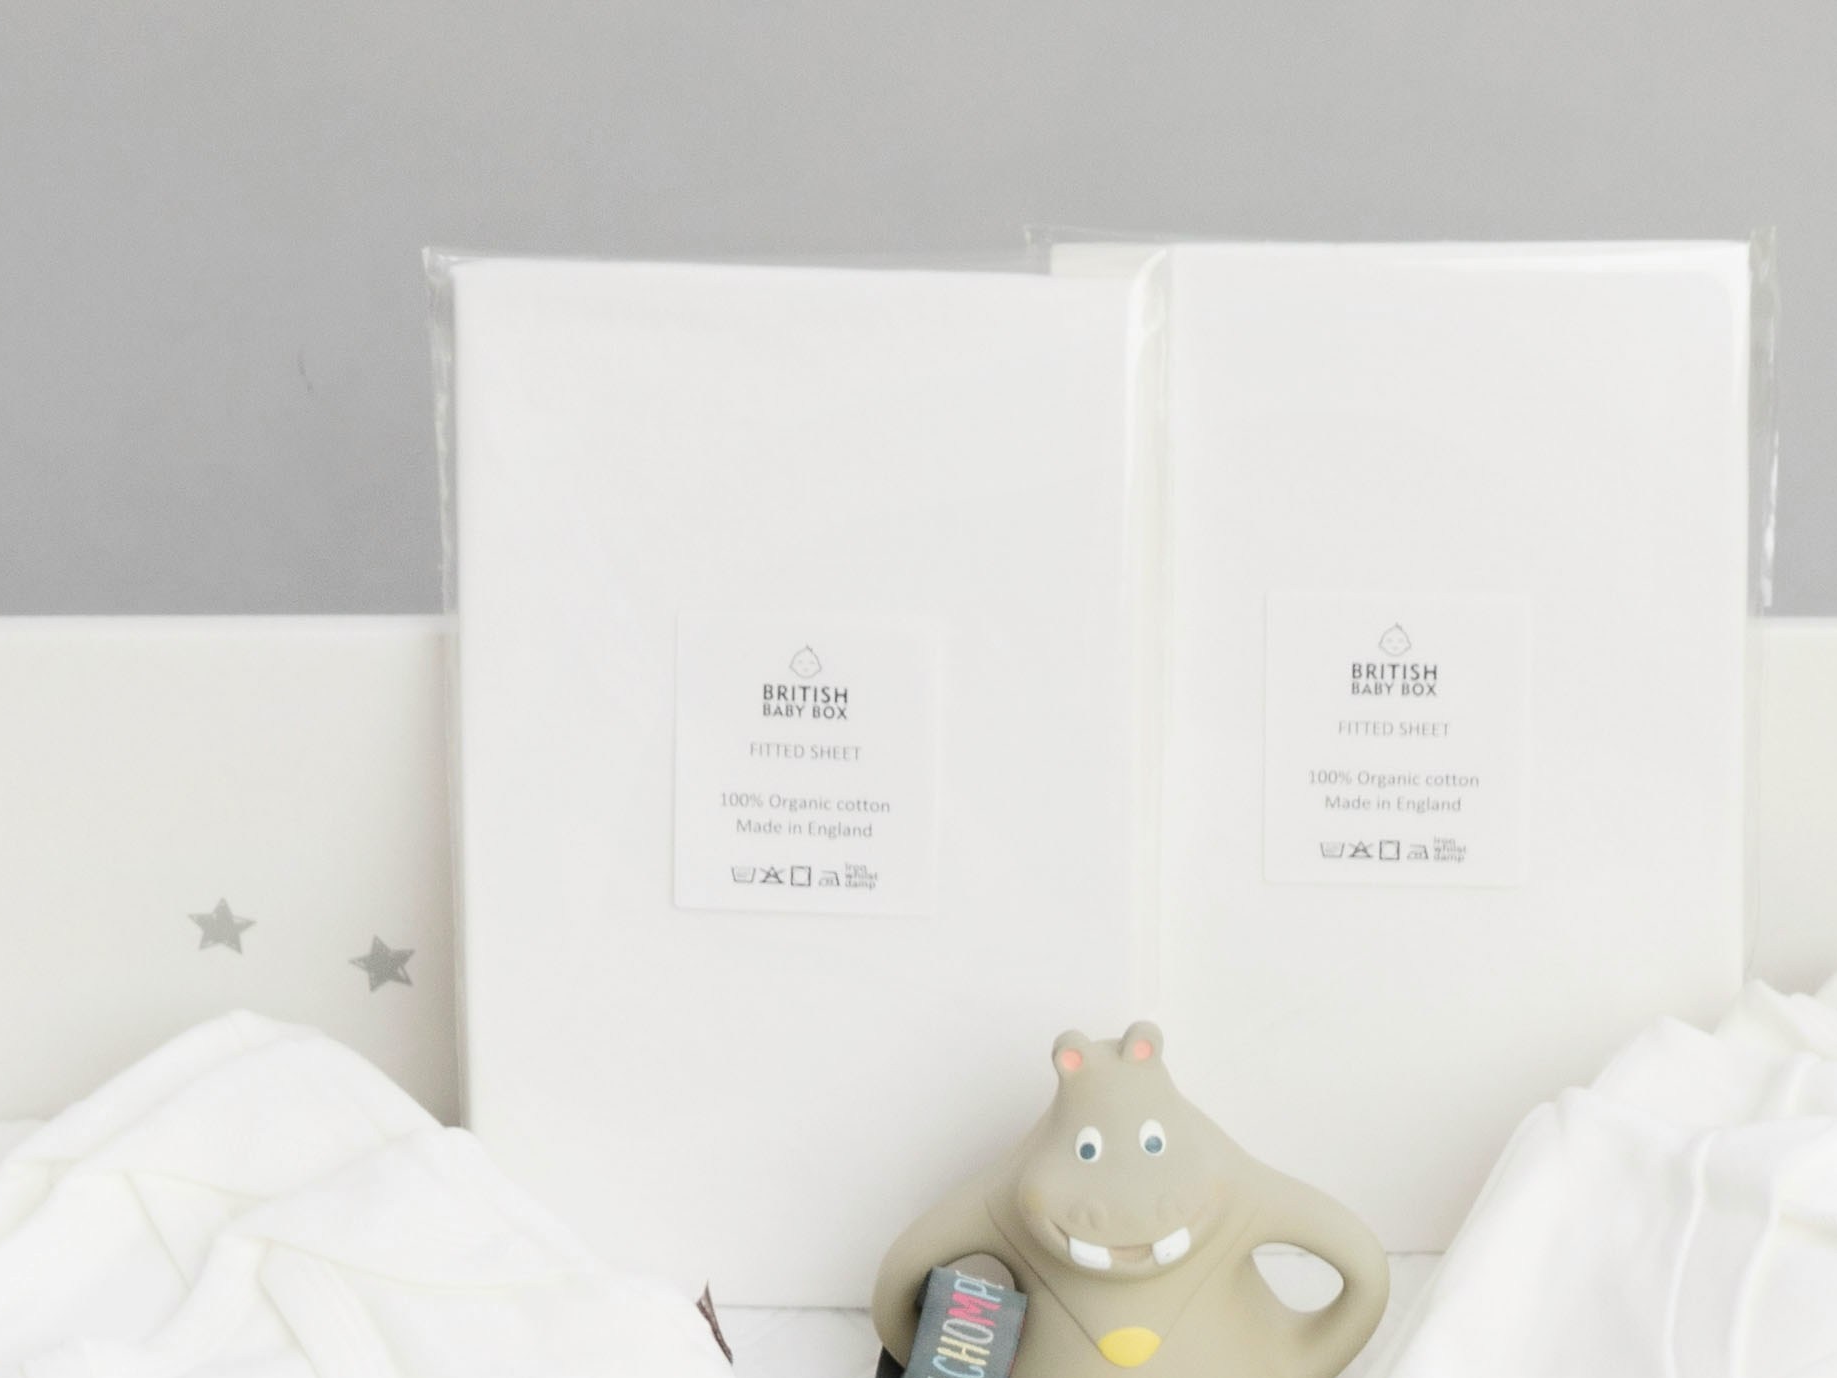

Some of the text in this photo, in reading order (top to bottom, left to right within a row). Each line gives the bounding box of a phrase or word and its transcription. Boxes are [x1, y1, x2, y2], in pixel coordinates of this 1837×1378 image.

[1352, 663, 1438, 680] BRITISH
[763, 684, 848, 704] BRITISH
[1352, 682, 1437, 696] BABY BOX
[763, 703, 847, 720] BABY BOX
[1338, 721, 1450, 737] FITTED SHEET
[749, 742, 862, 761] FITTED SHEET
[1308, 770, 1479, 789] 100% Organic cotton
[720, 792, 890, 813] 100% Organic cotton
[1325, 795, 1462, 813] Made in England
[736, 818, 873, 838] Made in England
